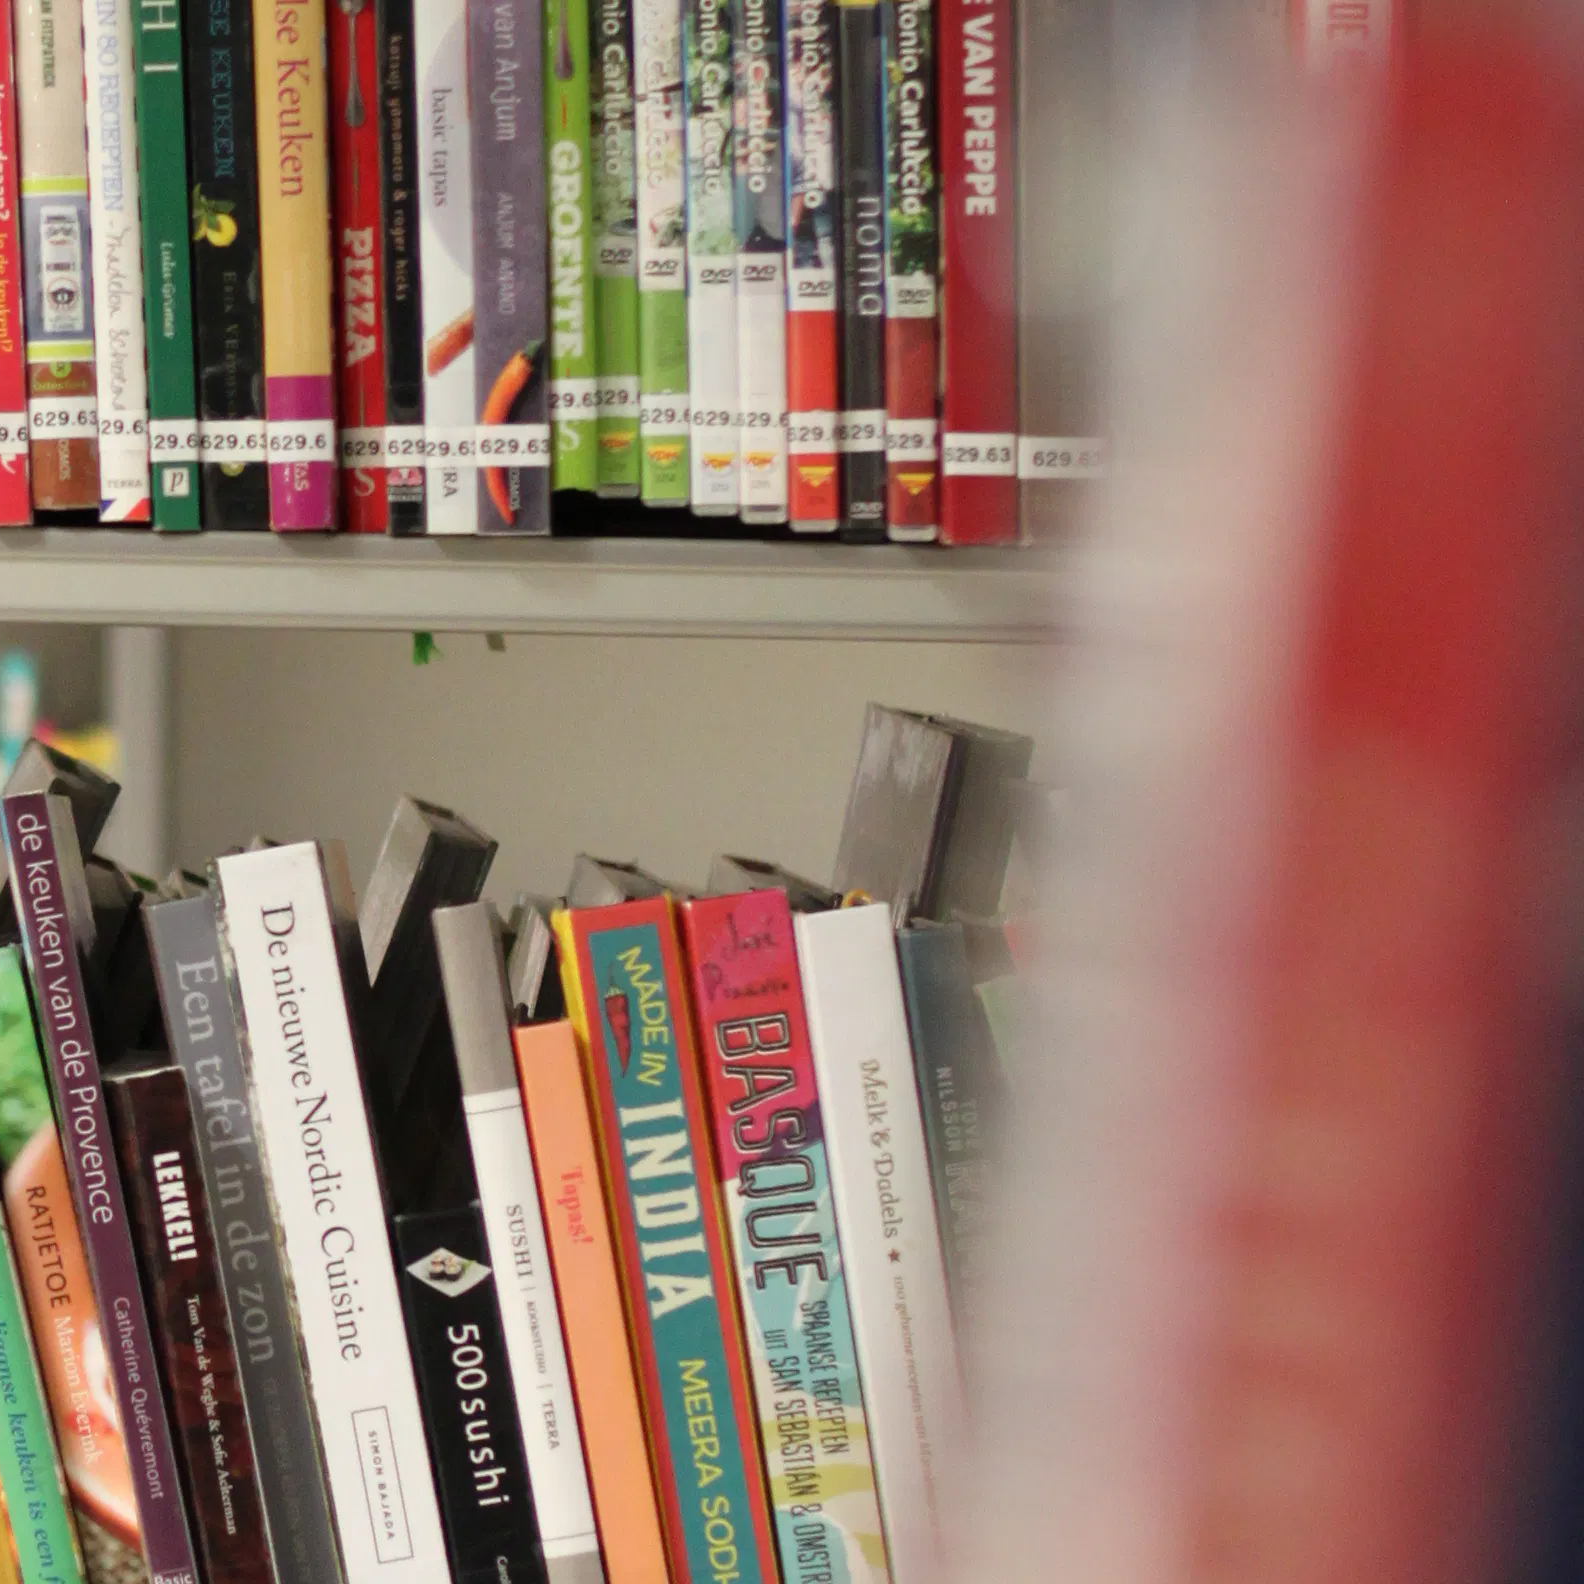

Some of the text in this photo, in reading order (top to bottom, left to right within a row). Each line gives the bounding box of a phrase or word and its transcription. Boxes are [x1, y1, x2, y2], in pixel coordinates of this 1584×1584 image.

[603, 43, 627, 175] Carluccio
[963, 14, 995, 96] VAN
[275, 57, 313, 198] Keuken
[428, 87, 454, 208] basic tapas
[964, 105, 998, 217] PEPPE
[497, 191, 515, 249] ANJUM
[550, 140, 585, 358] GROENTE
[855, 195, 883, 316] noma
[342, 226, 377, 368] PIZZA
[617, 945, 670, 1088] MADE IN
[16, 812, 142, 1385] de keuken van de Provence Catherine
[175, 954, 275, 1365] Een tafel in de zon
[260, 901, 365, 1362] De nieuwe Nordic Cuisine
[714, 1011, 829, 1292] BASQUE
[25, 1183, 71, 1310] RATJETOE
[506, 1203, 535, 1278] SUSHI
[617, 1096, 716, 1321] INDIA
[873, 1150, 905, 1241] Dadels
[447, 1321, 510, 1509] 500 sushi
[541, 1399, 560, 1452] TERRA
[679, 1357, 725, 1489] MEERA
[768, 1353, 806, 1396] SAN
[799, 1299, 850, 1457] SPAANSE RECEPTEN
[368, 1429, 396, 1542] SIMON BAJADA
